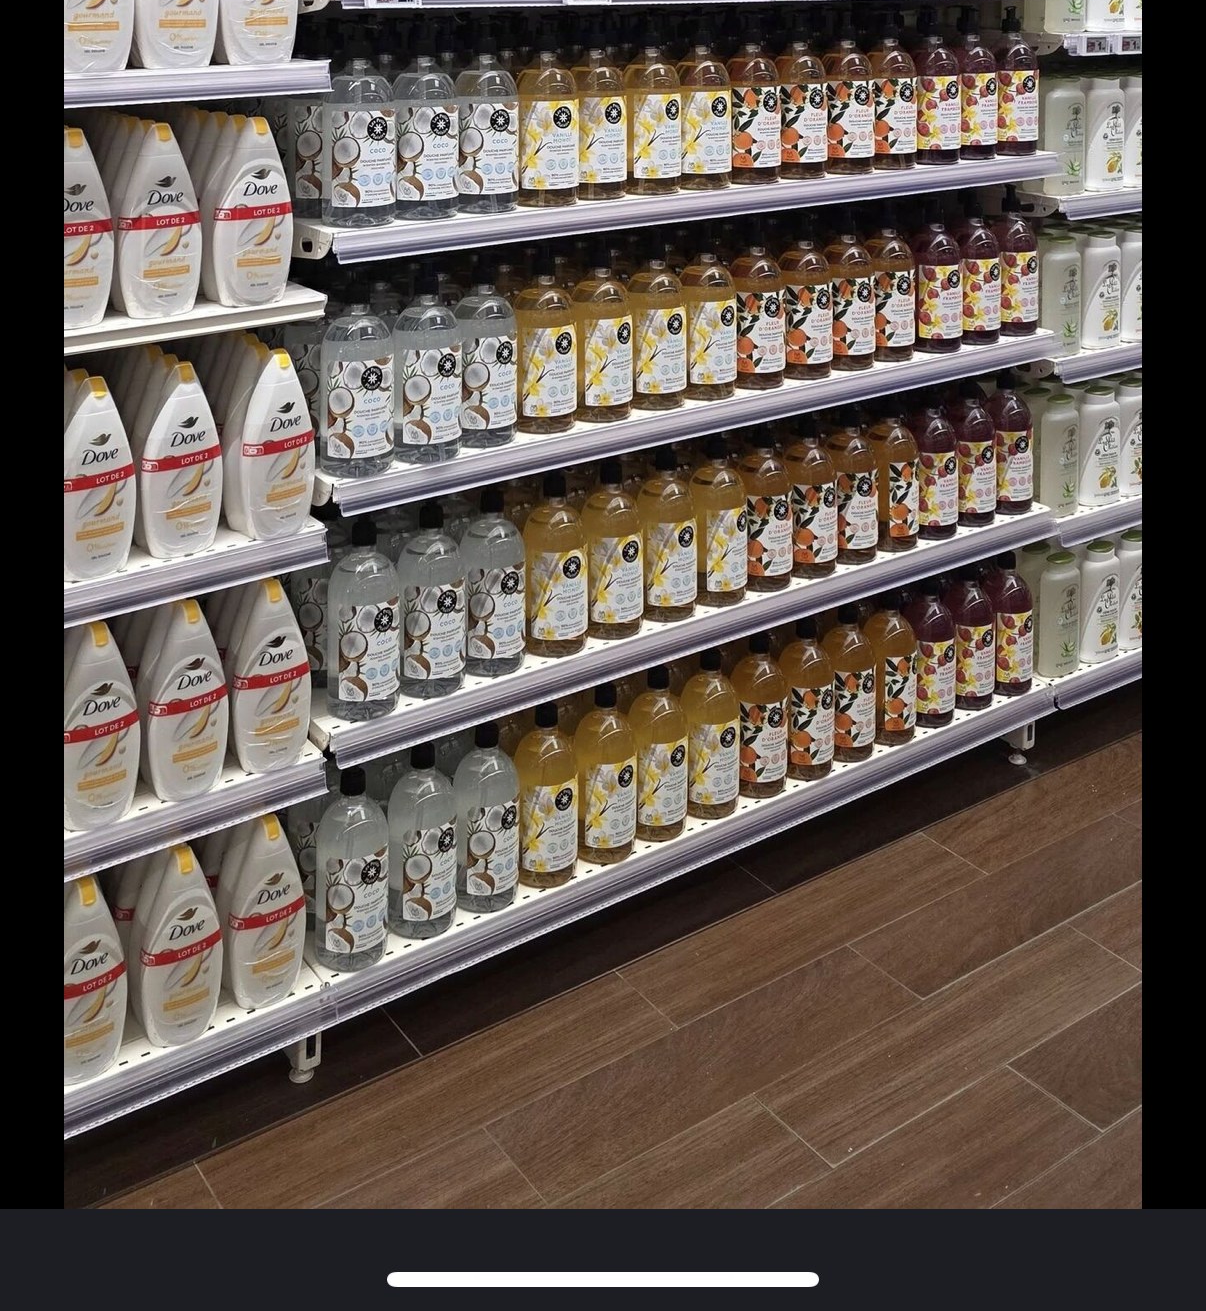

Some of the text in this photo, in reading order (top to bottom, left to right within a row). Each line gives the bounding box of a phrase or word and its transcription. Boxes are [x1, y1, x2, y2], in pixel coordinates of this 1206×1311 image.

[243, 181, 278, 196] Dove
[147, 190, 184, 206] Dove
[156, 216, 186, 226] LOT DE 2
[364, 396, 381, 404] COCO
[270, 415, 302, 432] Dove
[170, 430, 206, 448] Dove
[82, 447, 119, 466] Dove
[181, 452, 208, 465] LOT DE 2
[96, 470, 124, 484] LOT DE 2
[258, 648, 293, 666] Dove
[177, 670, 212, 690] Dove
[270, 670, 297, 685] LOT DE 2
[82, 696, 122, 716] Dove
[94, 720, 125, 736] LOT DE 2
[257, 884, 291, 905] Dove
[168, 919, 206, 941] Dove
[70, 952, 109, 976] Dove
